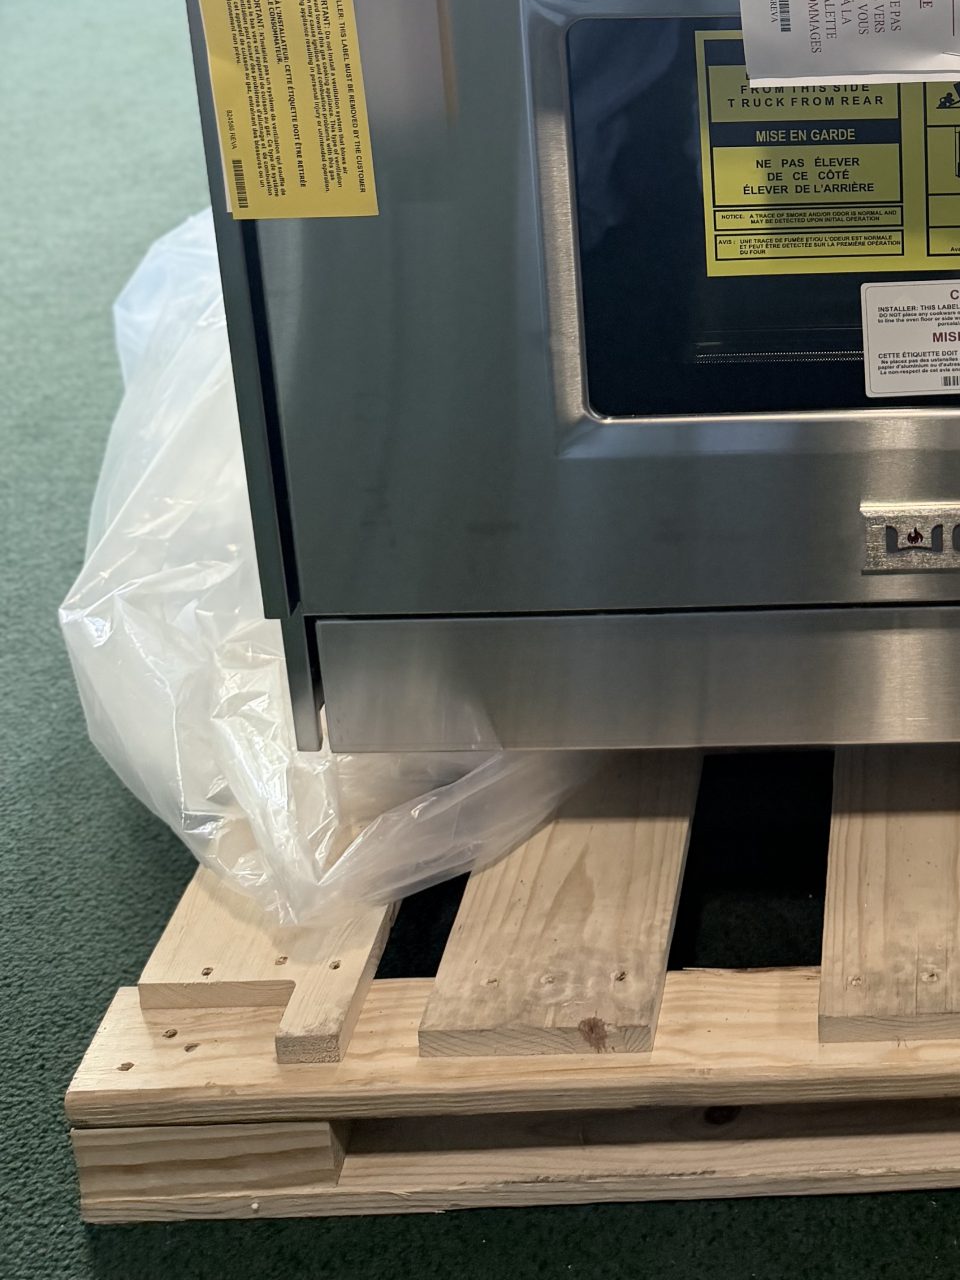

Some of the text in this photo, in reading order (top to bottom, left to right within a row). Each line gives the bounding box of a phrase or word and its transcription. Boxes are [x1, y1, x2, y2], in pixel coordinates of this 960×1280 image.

[839, 9, 854, 26] LA
[856, 3, 870, 36] VOUS
[872, 4, 886, 34] VERS
[889, 11, 902, 33] PAS
[268, 6, 282, 64] CONSOMMATEUR.
[338, 21, 347, 38] THIS
[340, 38, 350, 62] LABEL
[343, 62, 352, 82] MUST
[345, 83, 354, 94] BE
[791, 96, 835, 107] FROM
[841, 95, 884, 106] REAR
[347, 93, 358, 128] REMOVED
[351, 128, 360, 139] BY
[755, 128, 856, 143] MISE EN GARDE
[353, 140, 361, 154] THE
[755, 156, 860, 169] NE PAS ÉLEVER
[354, 154, 366, 193] CUSTOMER
[766, 169, 850, 181] DE CE CÔTÉ
[742, 182, 875, 196] ÉLEVER DE L'ARRIÈRE
[877, 305, 918, 313] INSTALLER:
[936, 303, 960, 311] LABEL
